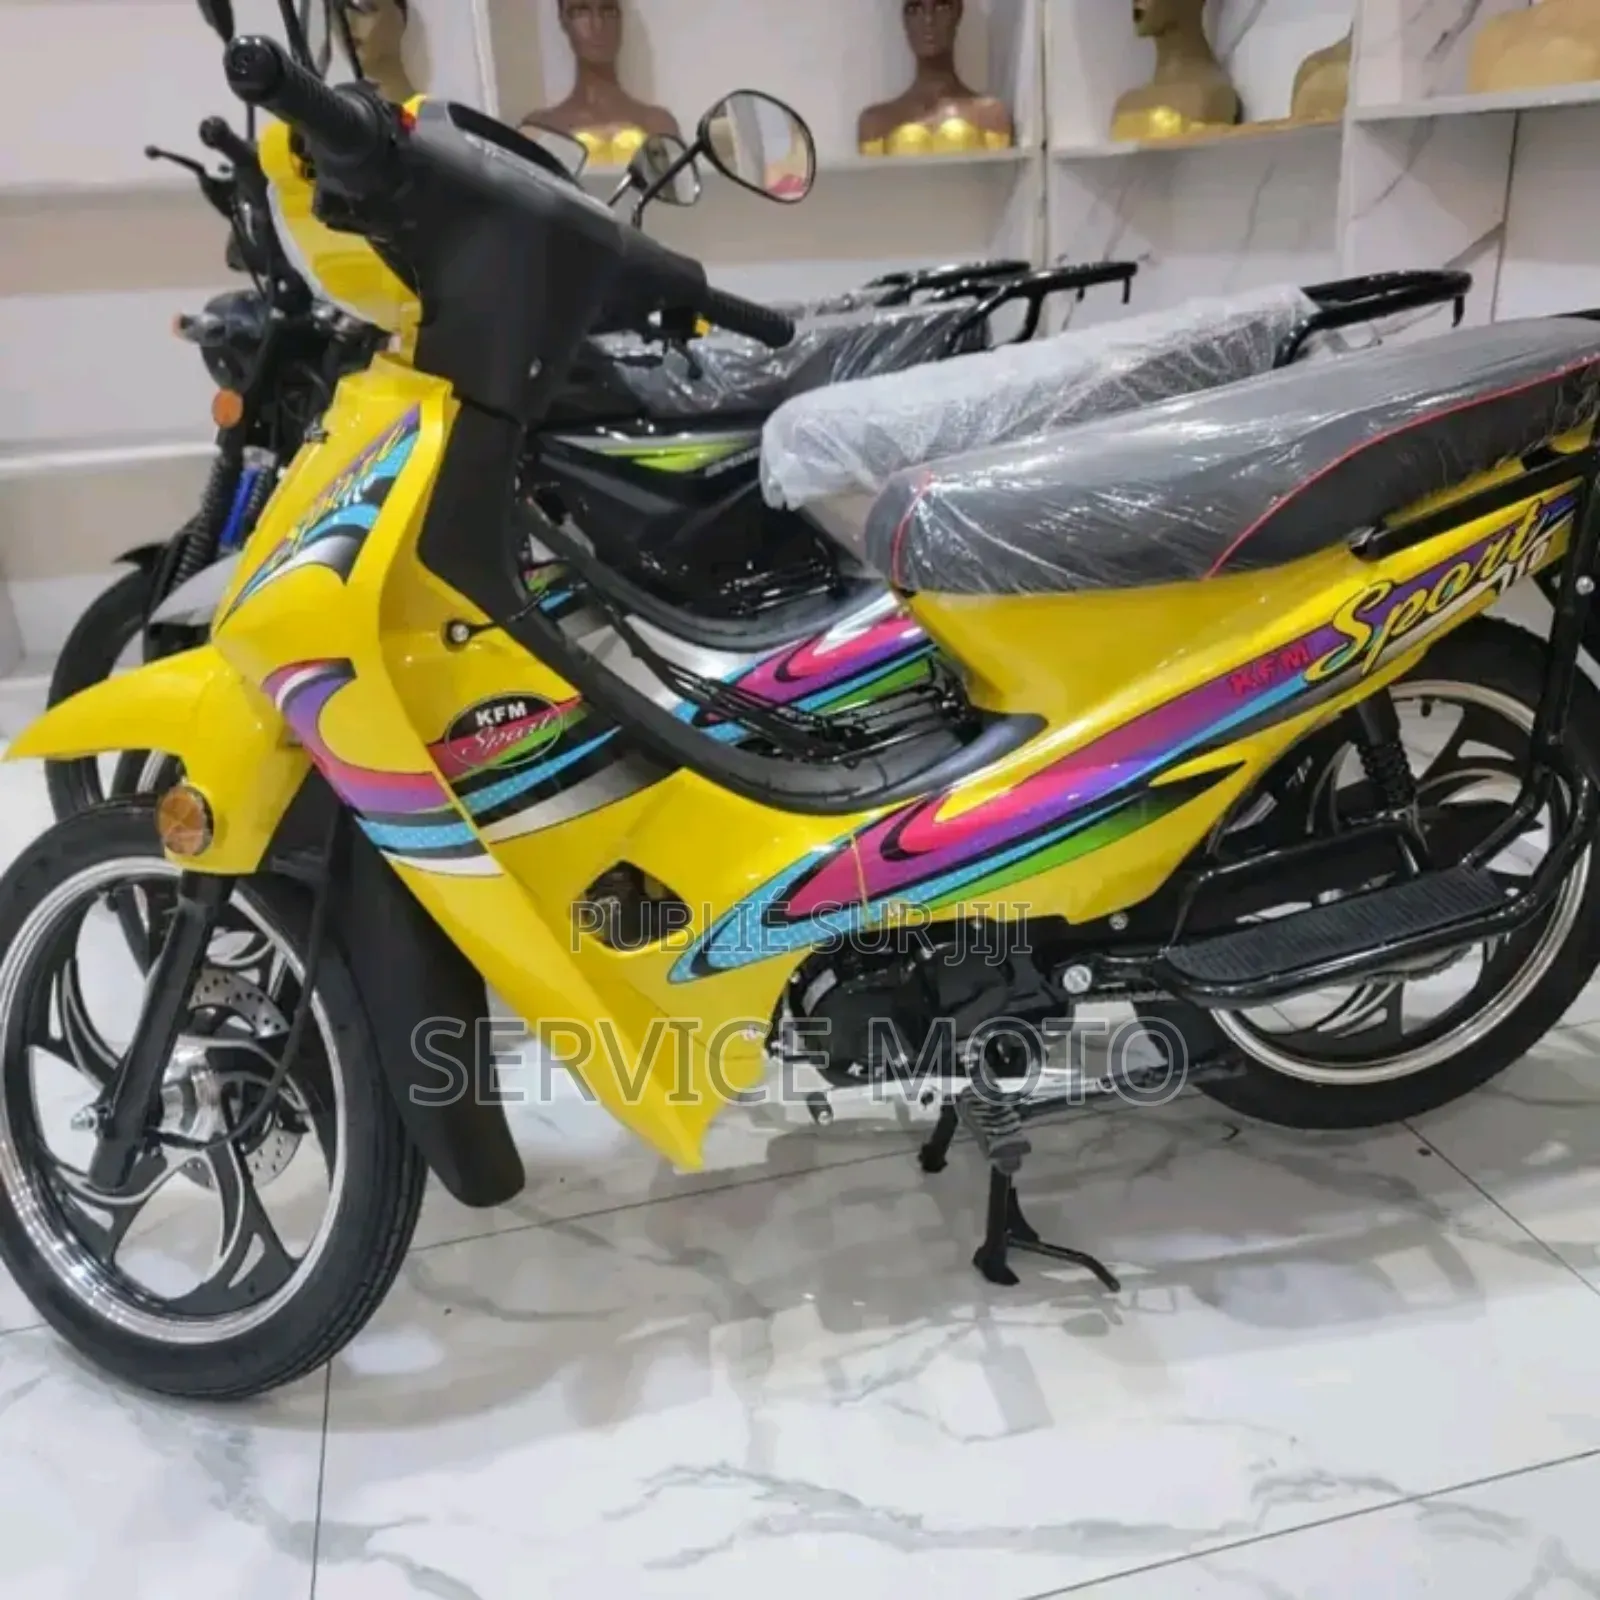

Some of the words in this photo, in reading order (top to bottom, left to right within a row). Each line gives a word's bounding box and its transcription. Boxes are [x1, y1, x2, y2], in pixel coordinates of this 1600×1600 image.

[1229, 644, 1309, 696] KFM
[1303, 497, 1543, 682] Sport
[460, 711, 553, 757] Sport
[474, 700, 528, 727] KFM
